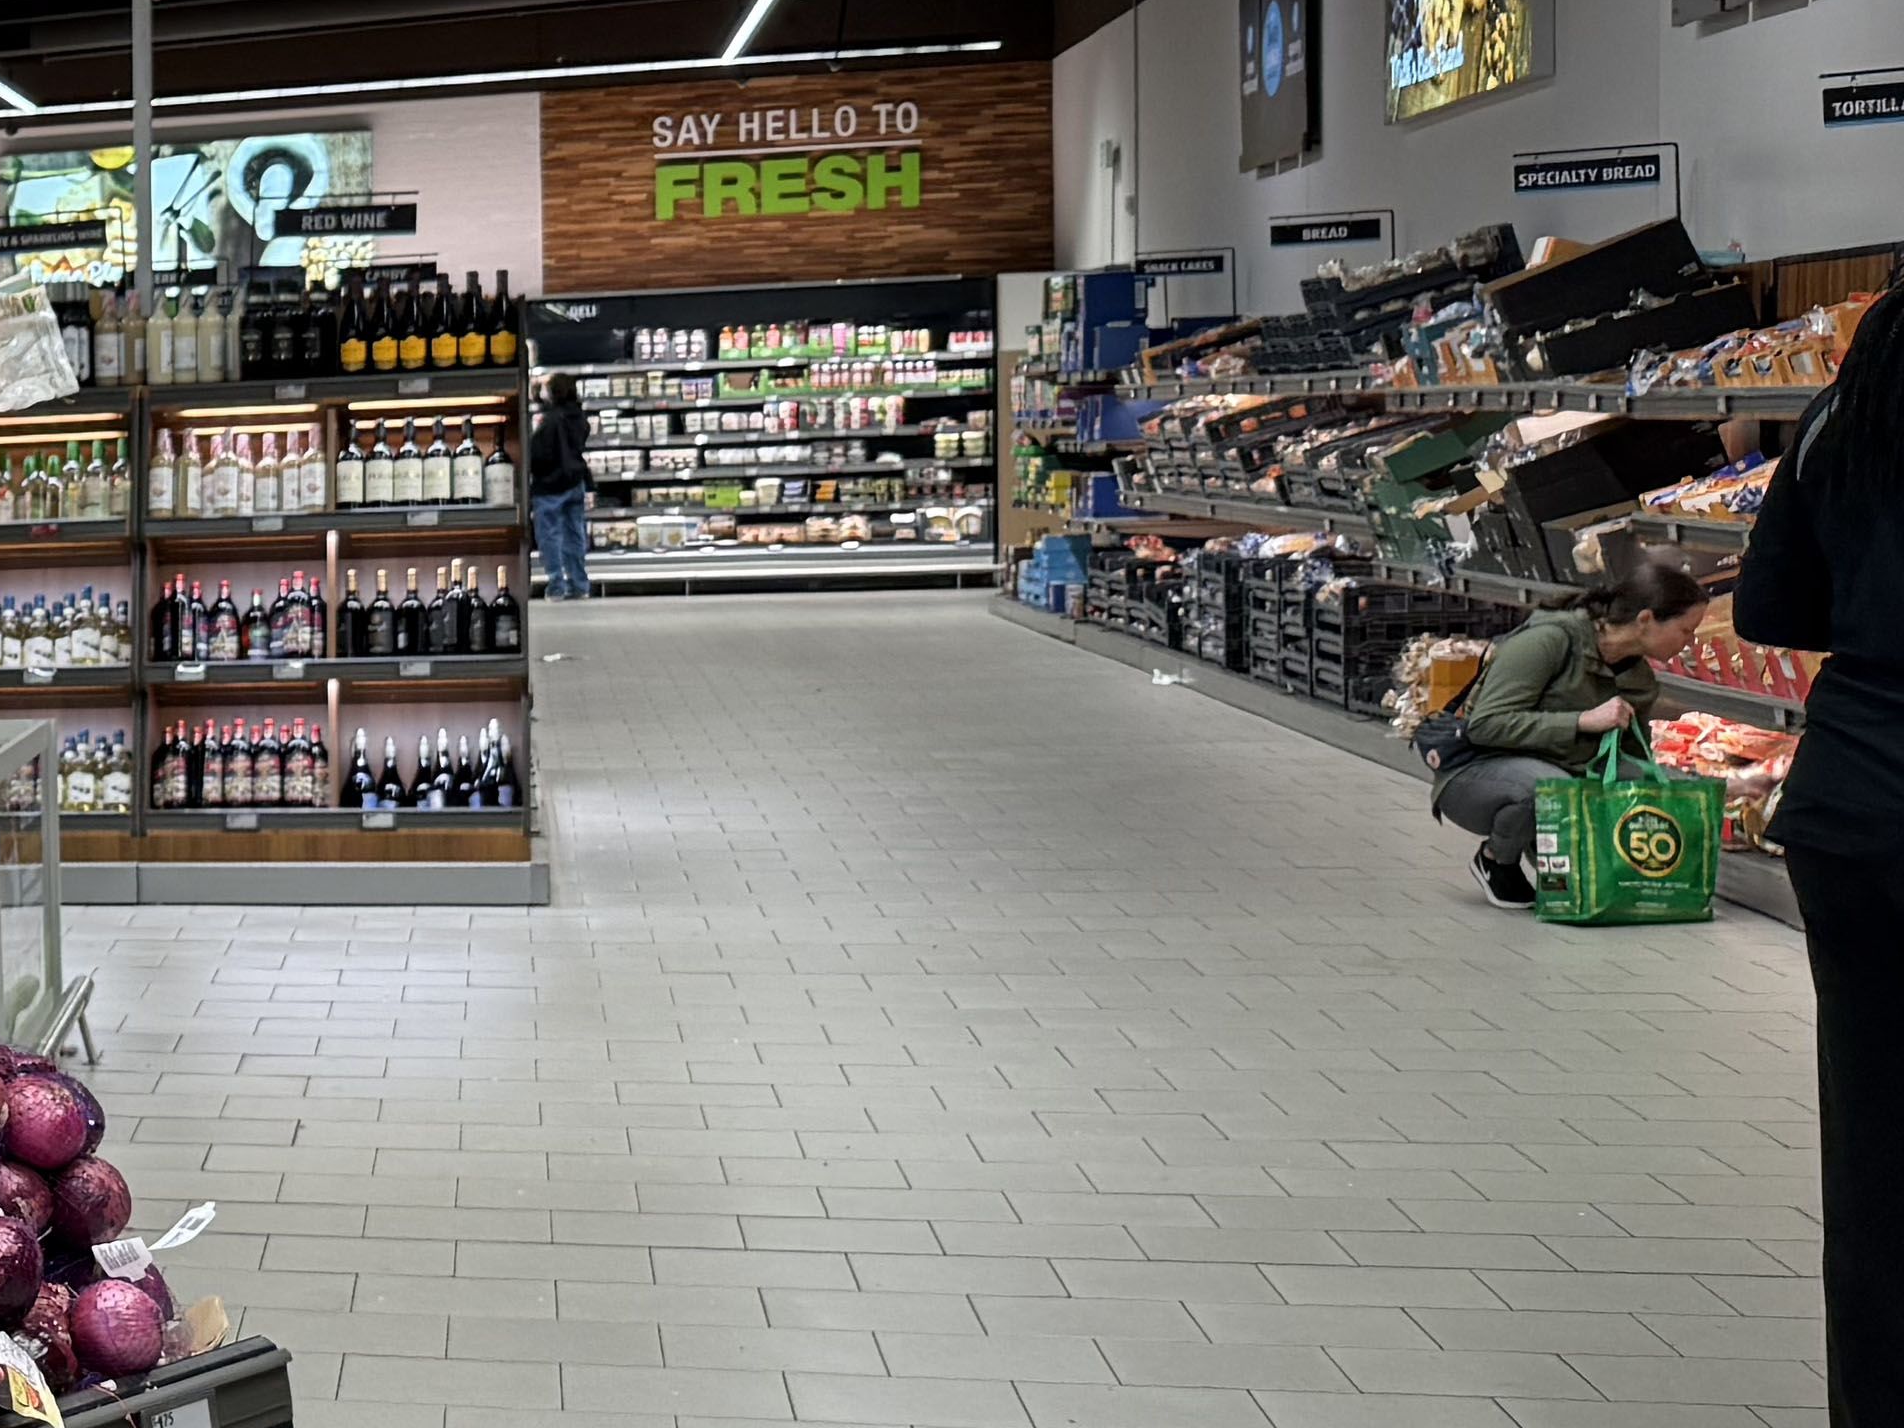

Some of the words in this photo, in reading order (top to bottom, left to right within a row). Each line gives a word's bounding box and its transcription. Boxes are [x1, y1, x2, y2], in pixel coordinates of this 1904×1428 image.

[1832, 97, 1904, 117] TORTILL
[652, 112, 721, 148] SAY
[738, 105, 857, 143] HELLO
[872, 101, 919, 135] TO
[655, 151, 922, 222] FRESH
[1517, 166, 1598, 188] SPECIALTY
[1601, 162, 1656, 182] BREAD
[301, 213, 339, 231] RED
[341, 210, 388, 229] WINE
[1301, 224, 1349, 241] BREAD
[1630, 831, 1676, 862] 50
